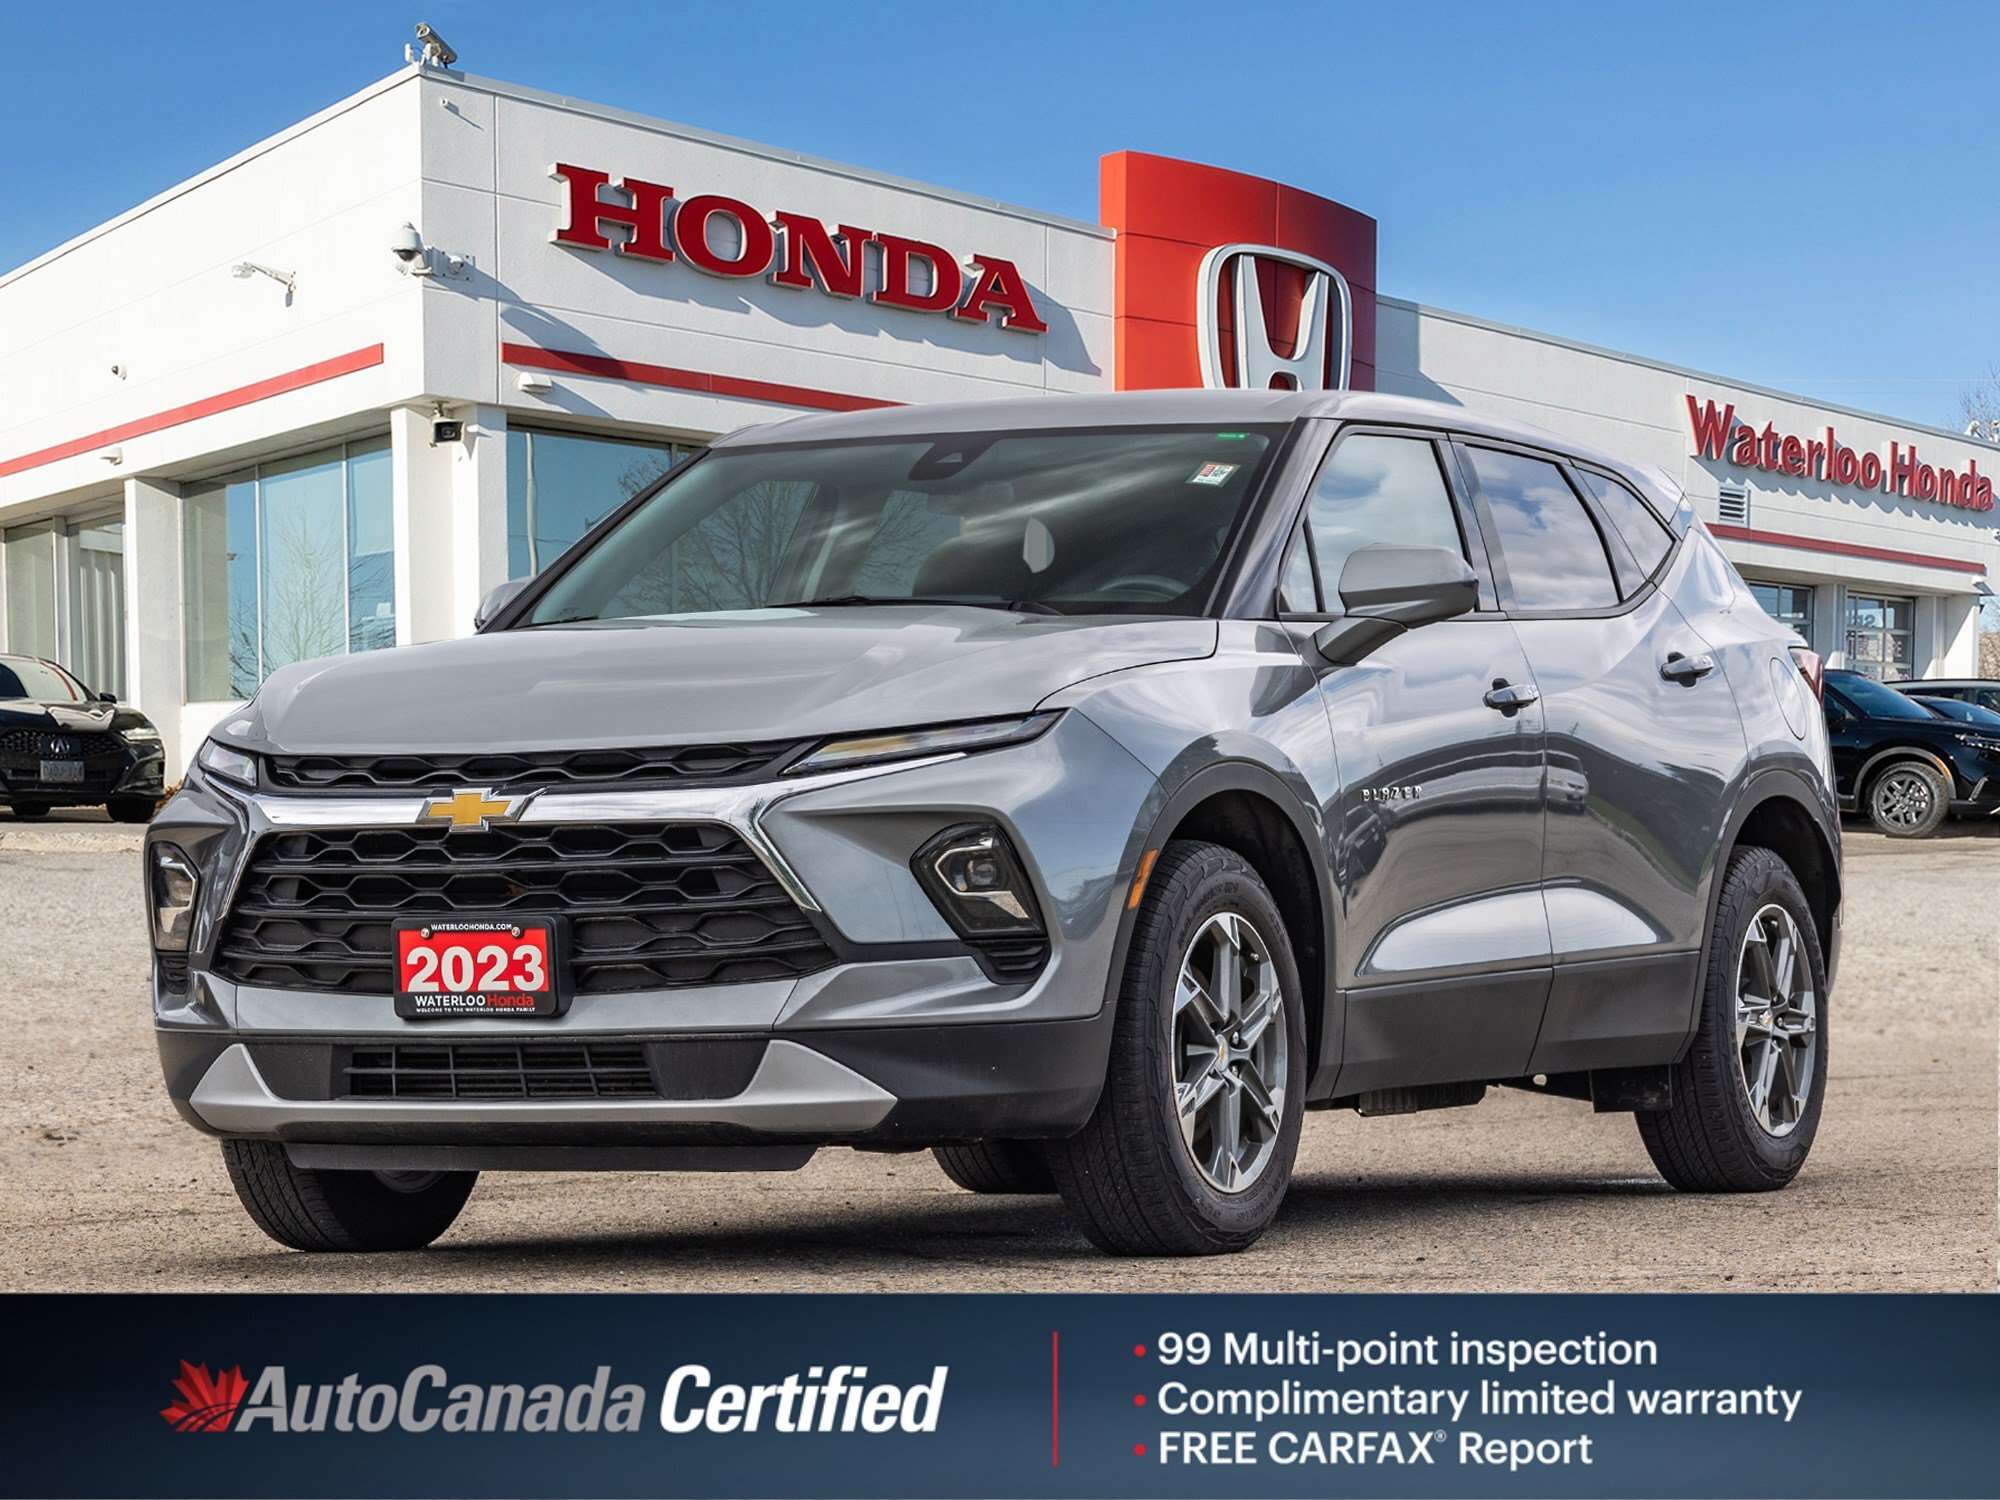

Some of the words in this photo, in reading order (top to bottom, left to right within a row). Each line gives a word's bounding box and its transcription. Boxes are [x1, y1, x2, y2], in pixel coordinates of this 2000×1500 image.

[549, 162, 1048, 335] HONDA
[1685, 394, 1882, 490] Waterloo
[1888, 441, 1995, 512] Honda
[1361, 785, 1423, 802] BLAZER
[430, 923, 513, 931] WATERLOOHONDA.COM
[406, 944, 545, 992] 2023
[414, 994, 486, 1007] WATERLOO
[486, 993, 535, 1007] Honda
